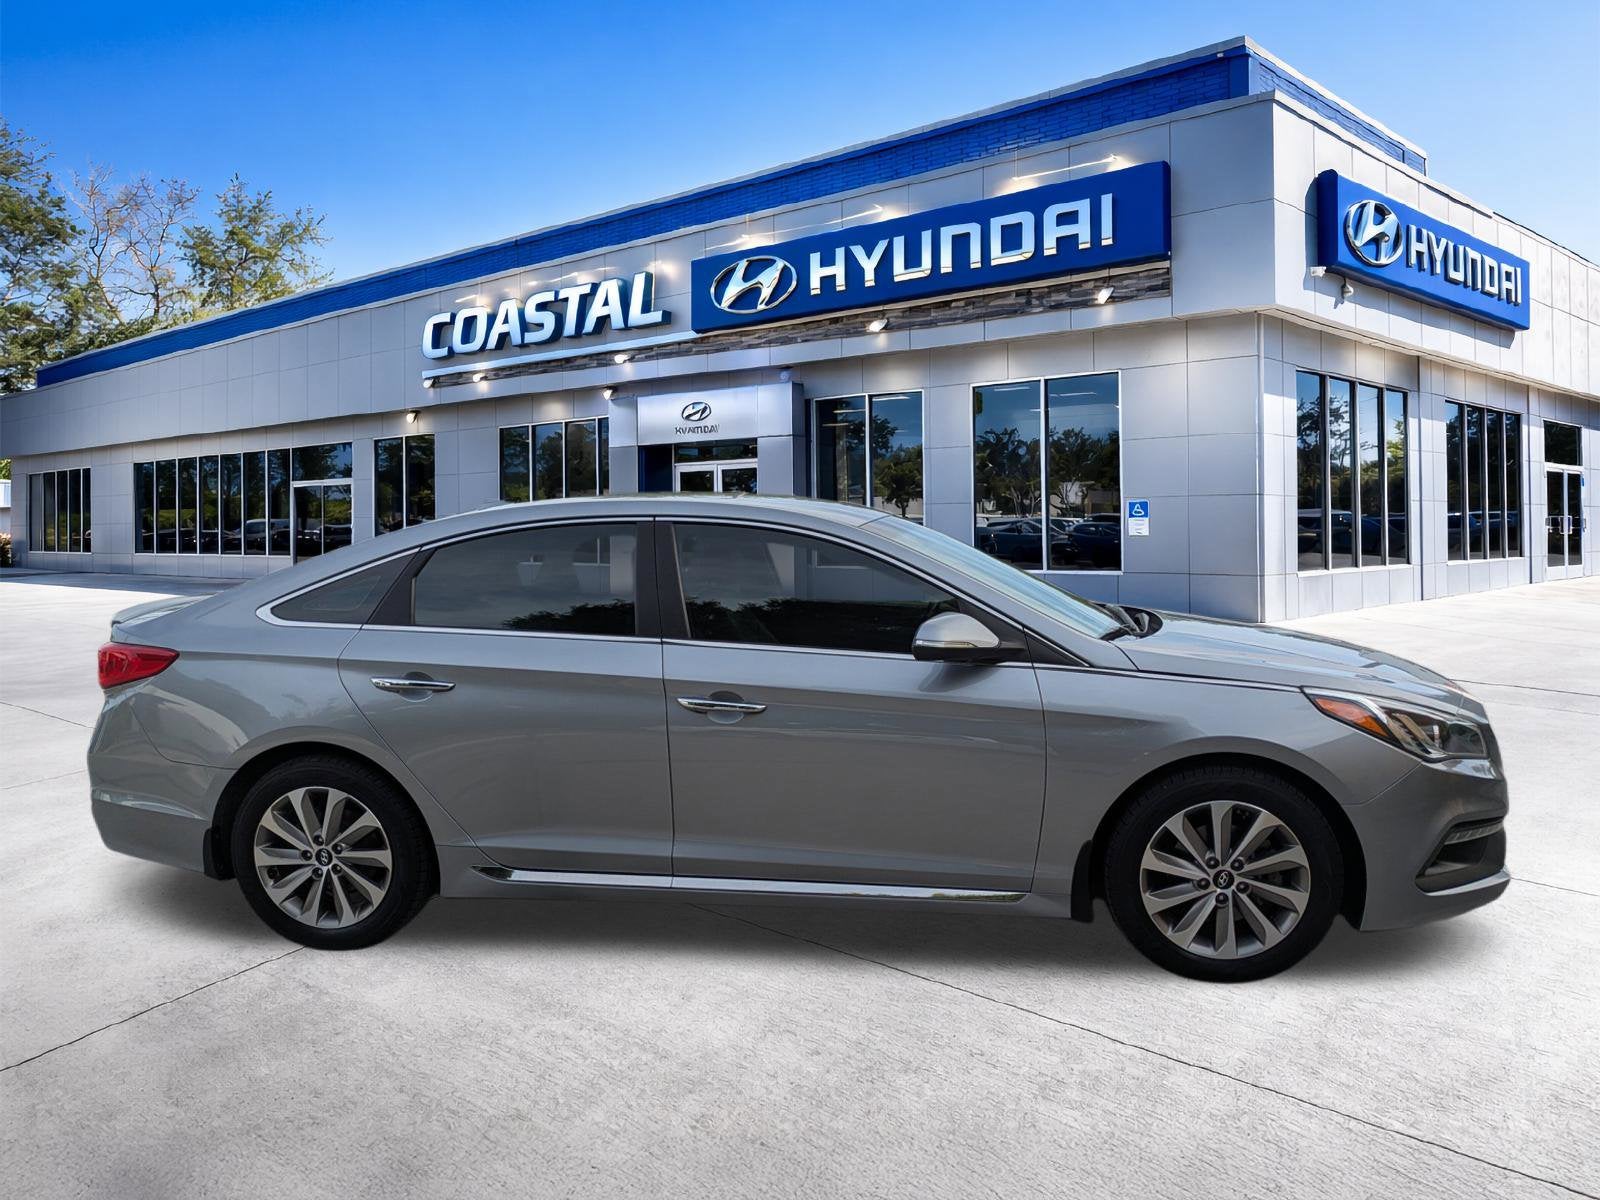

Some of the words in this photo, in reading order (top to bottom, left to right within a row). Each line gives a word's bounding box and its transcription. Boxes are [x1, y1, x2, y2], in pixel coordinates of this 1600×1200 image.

[810, 193, 1113, 295] HYUNDAI
[1406, 224, 1522, 306] HYUNDAI
[422, 271, 670, 360] COASTAL
